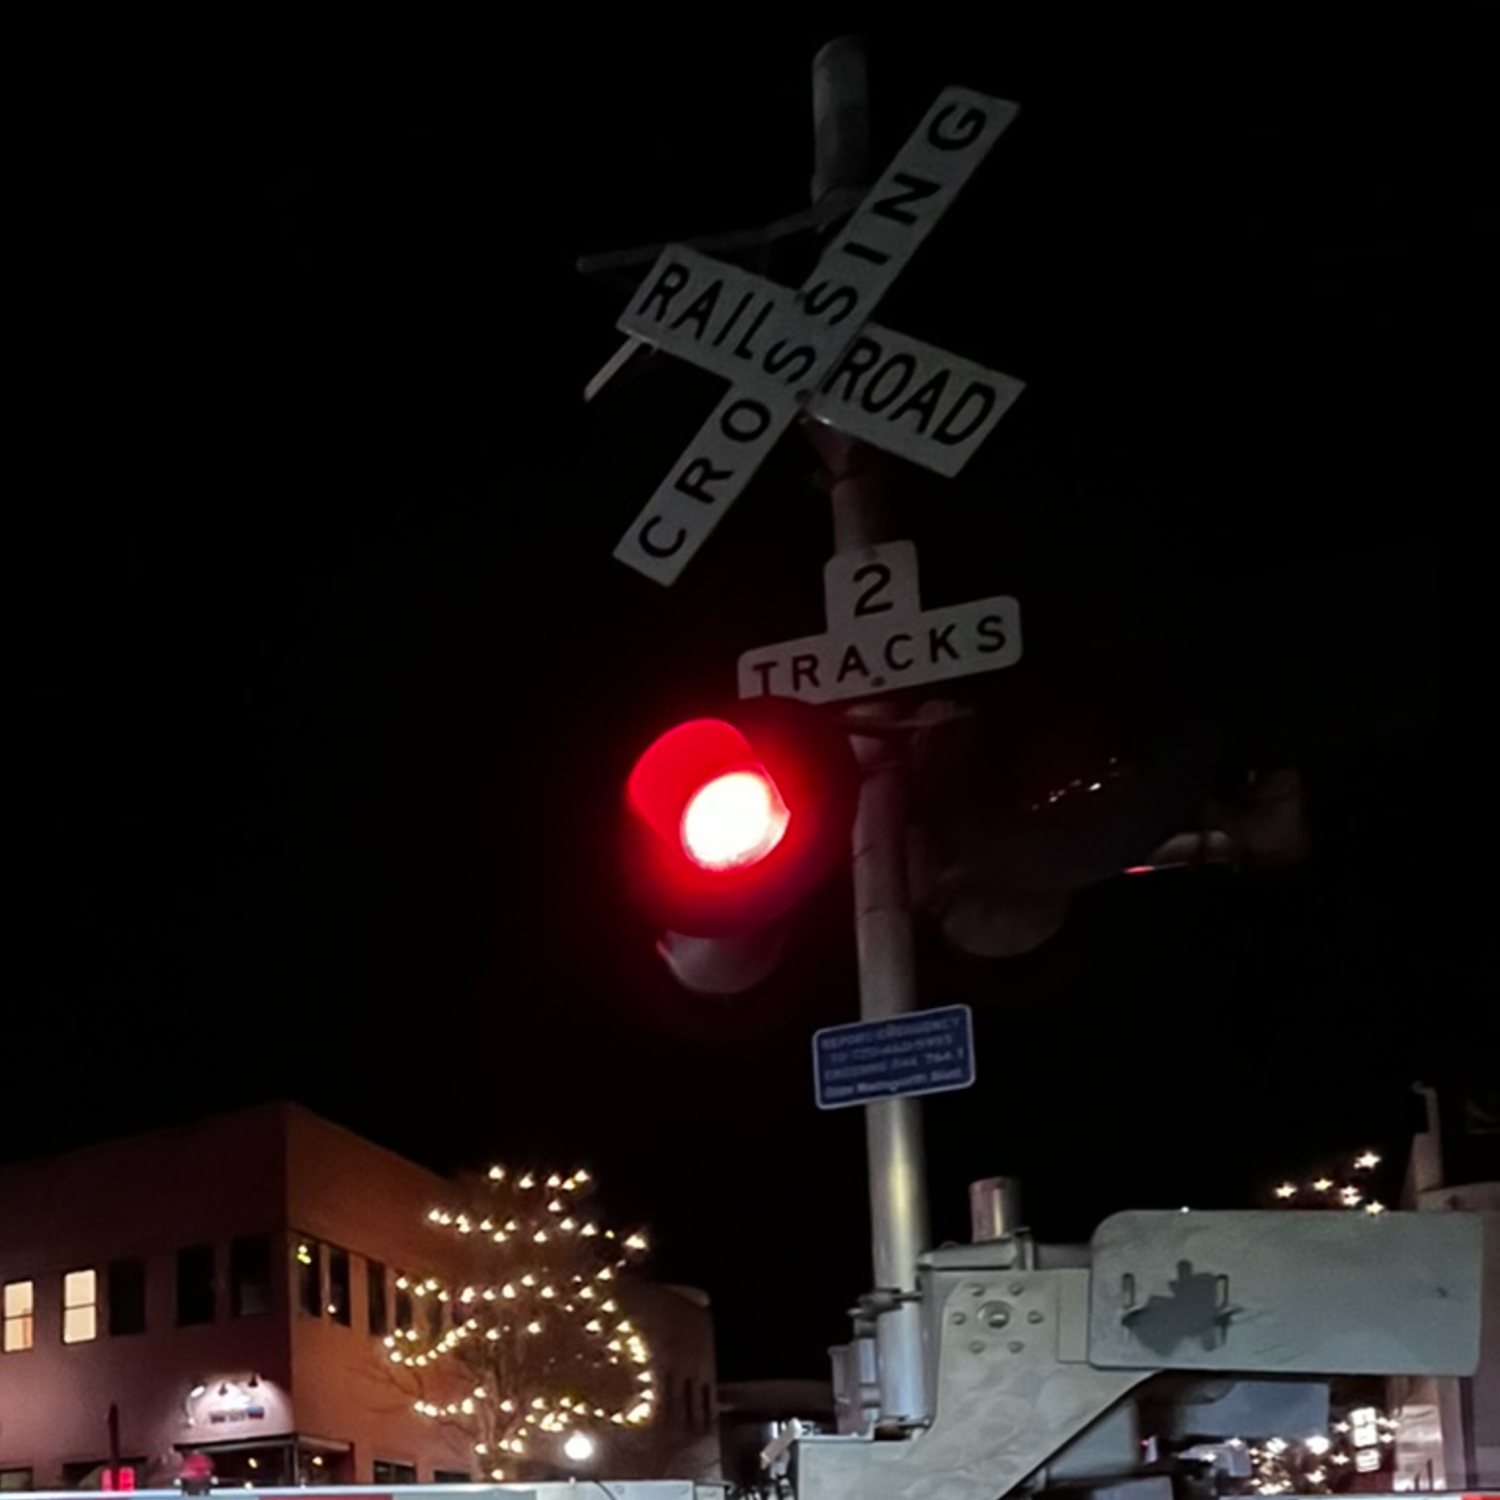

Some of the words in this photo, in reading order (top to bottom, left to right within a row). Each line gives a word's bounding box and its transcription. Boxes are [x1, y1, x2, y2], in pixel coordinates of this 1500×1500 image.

[637, 262, 775, 361] RAIL
[822, 336, 996, 446] ROAD
[638, 102, 986, 558] CROSSING
[753, 614, 1007, 699] TRACKS
[852, 563, 893, 618] 2
